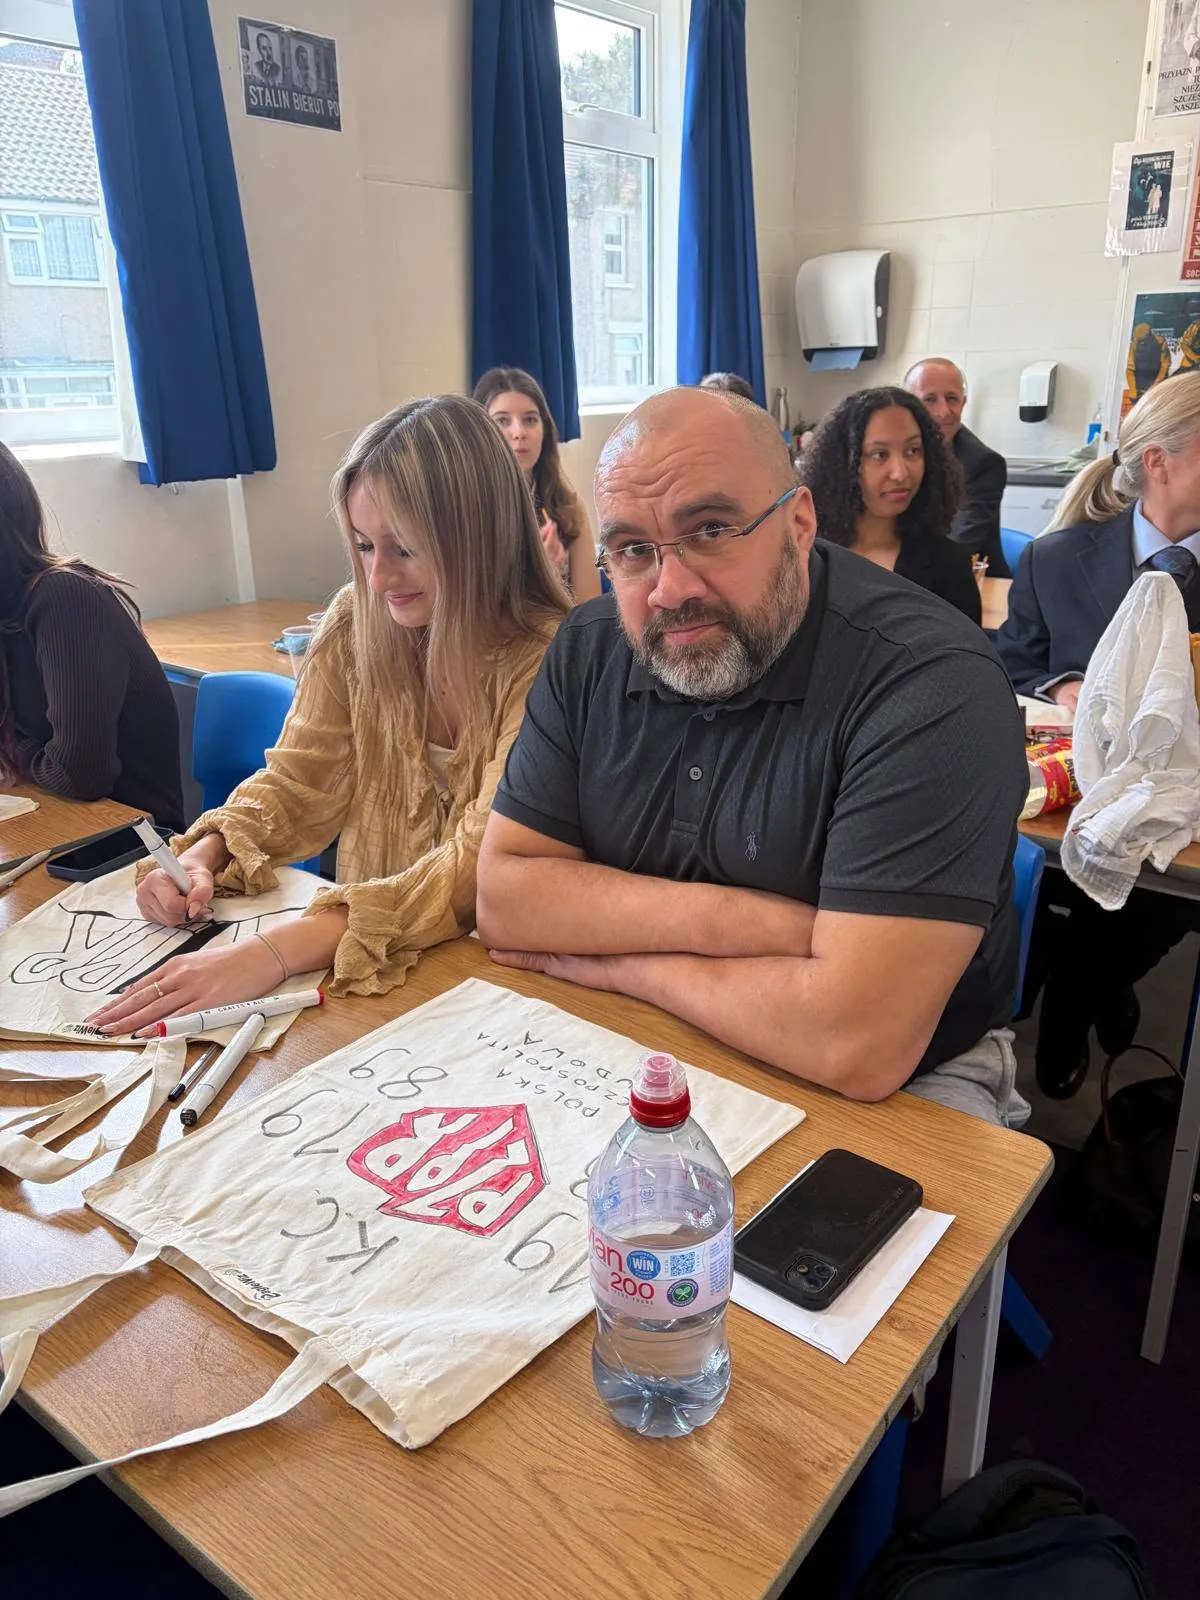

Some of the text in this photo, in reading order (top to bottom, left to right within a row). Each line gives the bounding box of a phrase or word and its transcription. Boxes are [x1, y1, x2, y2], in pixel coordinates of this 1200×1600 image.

[249, 85, 340, 117] STALIN BIERUT PO
[477, 1032, 630, 1107] CZPOSPOLITA
[523, 1031, 633, 1089] UDOWA
[496, 1068, 601, 1118] POLSKA
[631, 1257, 654, 1272] WIN
[610, 1272, 655, 1300] 200
